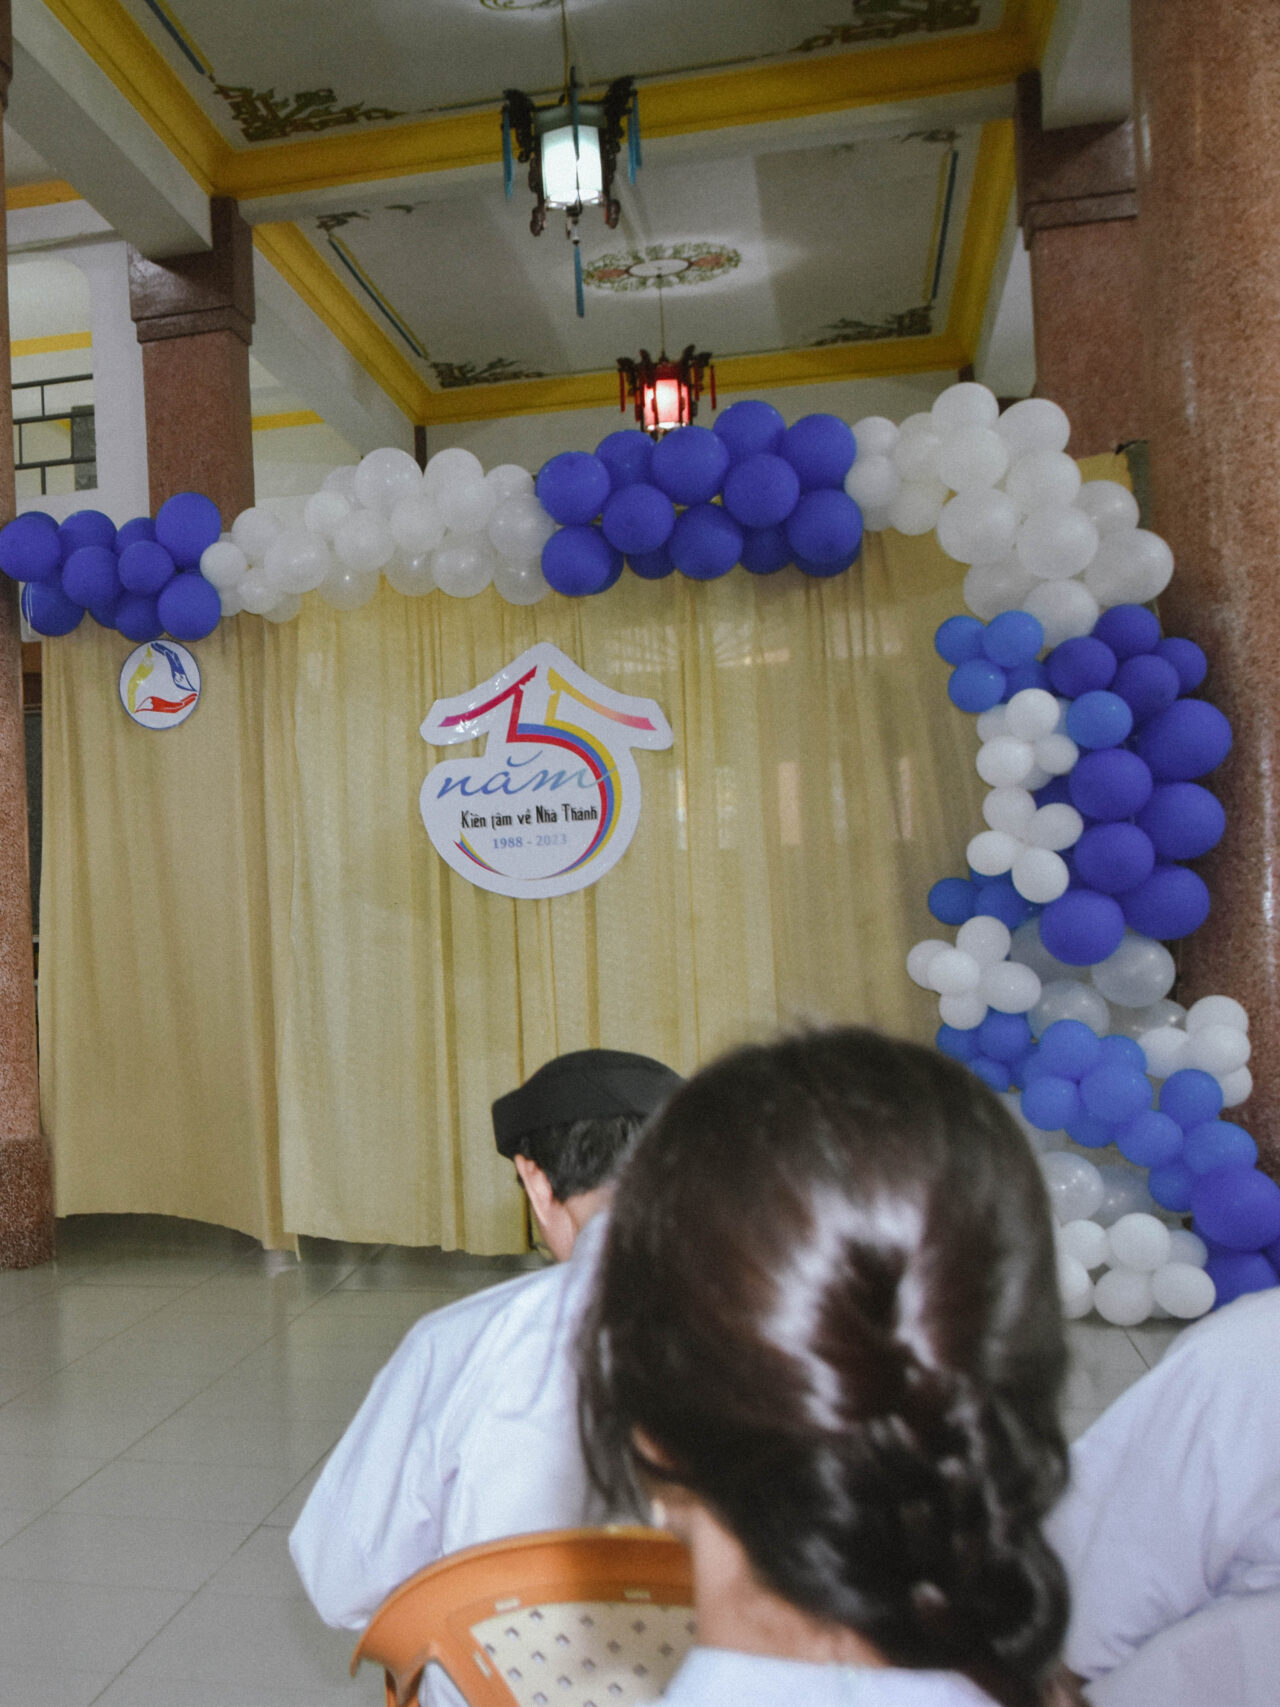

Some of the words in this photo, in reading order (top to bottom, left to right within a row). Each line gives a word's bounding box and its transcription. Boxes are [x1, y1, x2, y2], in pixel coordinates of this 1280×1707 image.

[436, 750, 617, 800] năm
[493, 836, 523, 849] 1988
[536, 833, 567, 847] 2023
